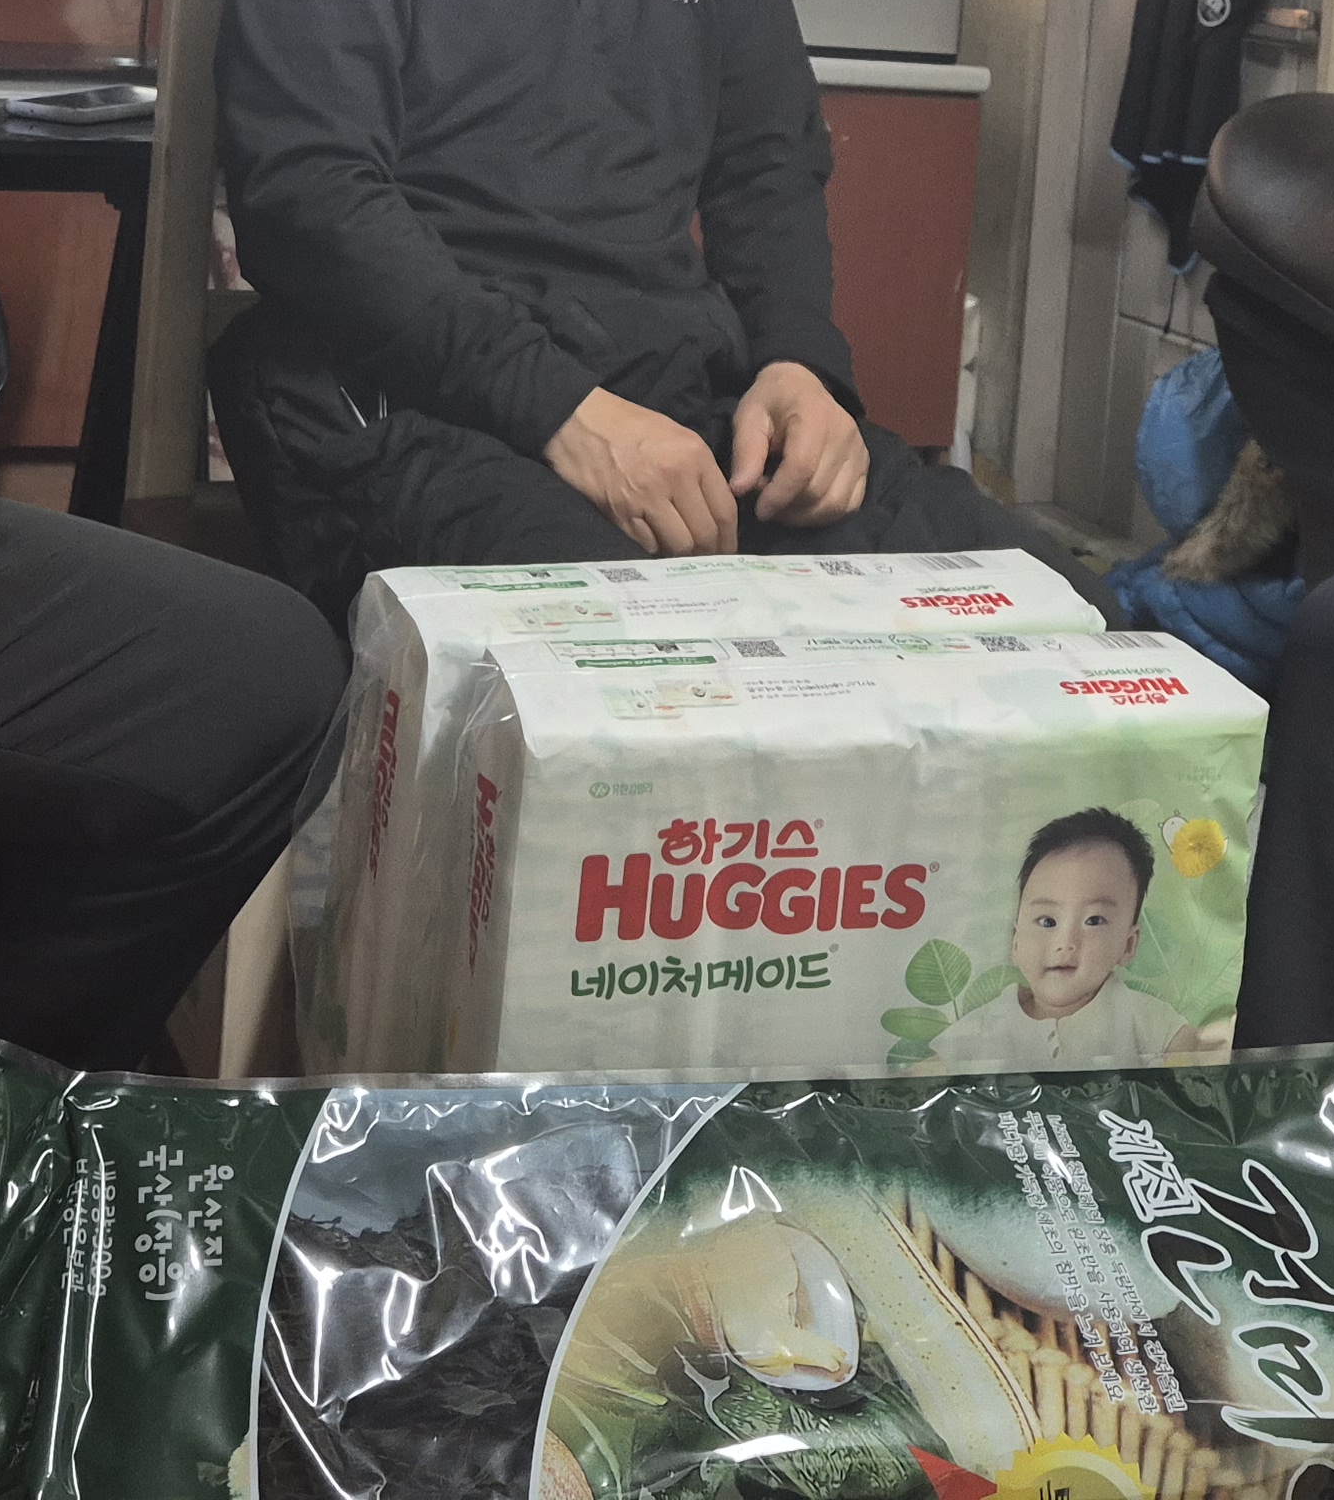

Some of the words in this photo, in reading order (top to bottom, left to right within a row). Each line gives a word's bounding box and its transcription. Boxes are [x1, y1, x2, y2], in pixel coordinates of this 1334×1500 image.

[900, 592, 1015, 608] HUGGIES
[1059, 676, 1190, 696] HUGGIES
[1108, 693, 1170, 707] 하기스
[658, 818, 818, 866] 하기스
[574, 853, 927, 943] HUGGIES
[569, 952, 833, 999] 네이처메이드
[187, 1164, 235, 1267] 원산지
[998, 1111, 1028, 1163] 바다향
[1014, 1163, 1048, 1210] 가득한
[1036, 1211, 1067, 1255] 해초의
[1056, 1259, 1088, 1312] 참맛을
[1090, 1350, 1125, 1403] 보세요
[1069, 1227, 1105, 1285] 원초만을
[1097, 1290, 1139, 1356] 사용하여
[1123, 1357, 1160, 1416] 생산한
[1092, 1227, 1118, 1257] 장흥
[1110, 1261, 1157, 1337] 득량만에서
[1144, 1340, 1188, 1413] 건져올린
